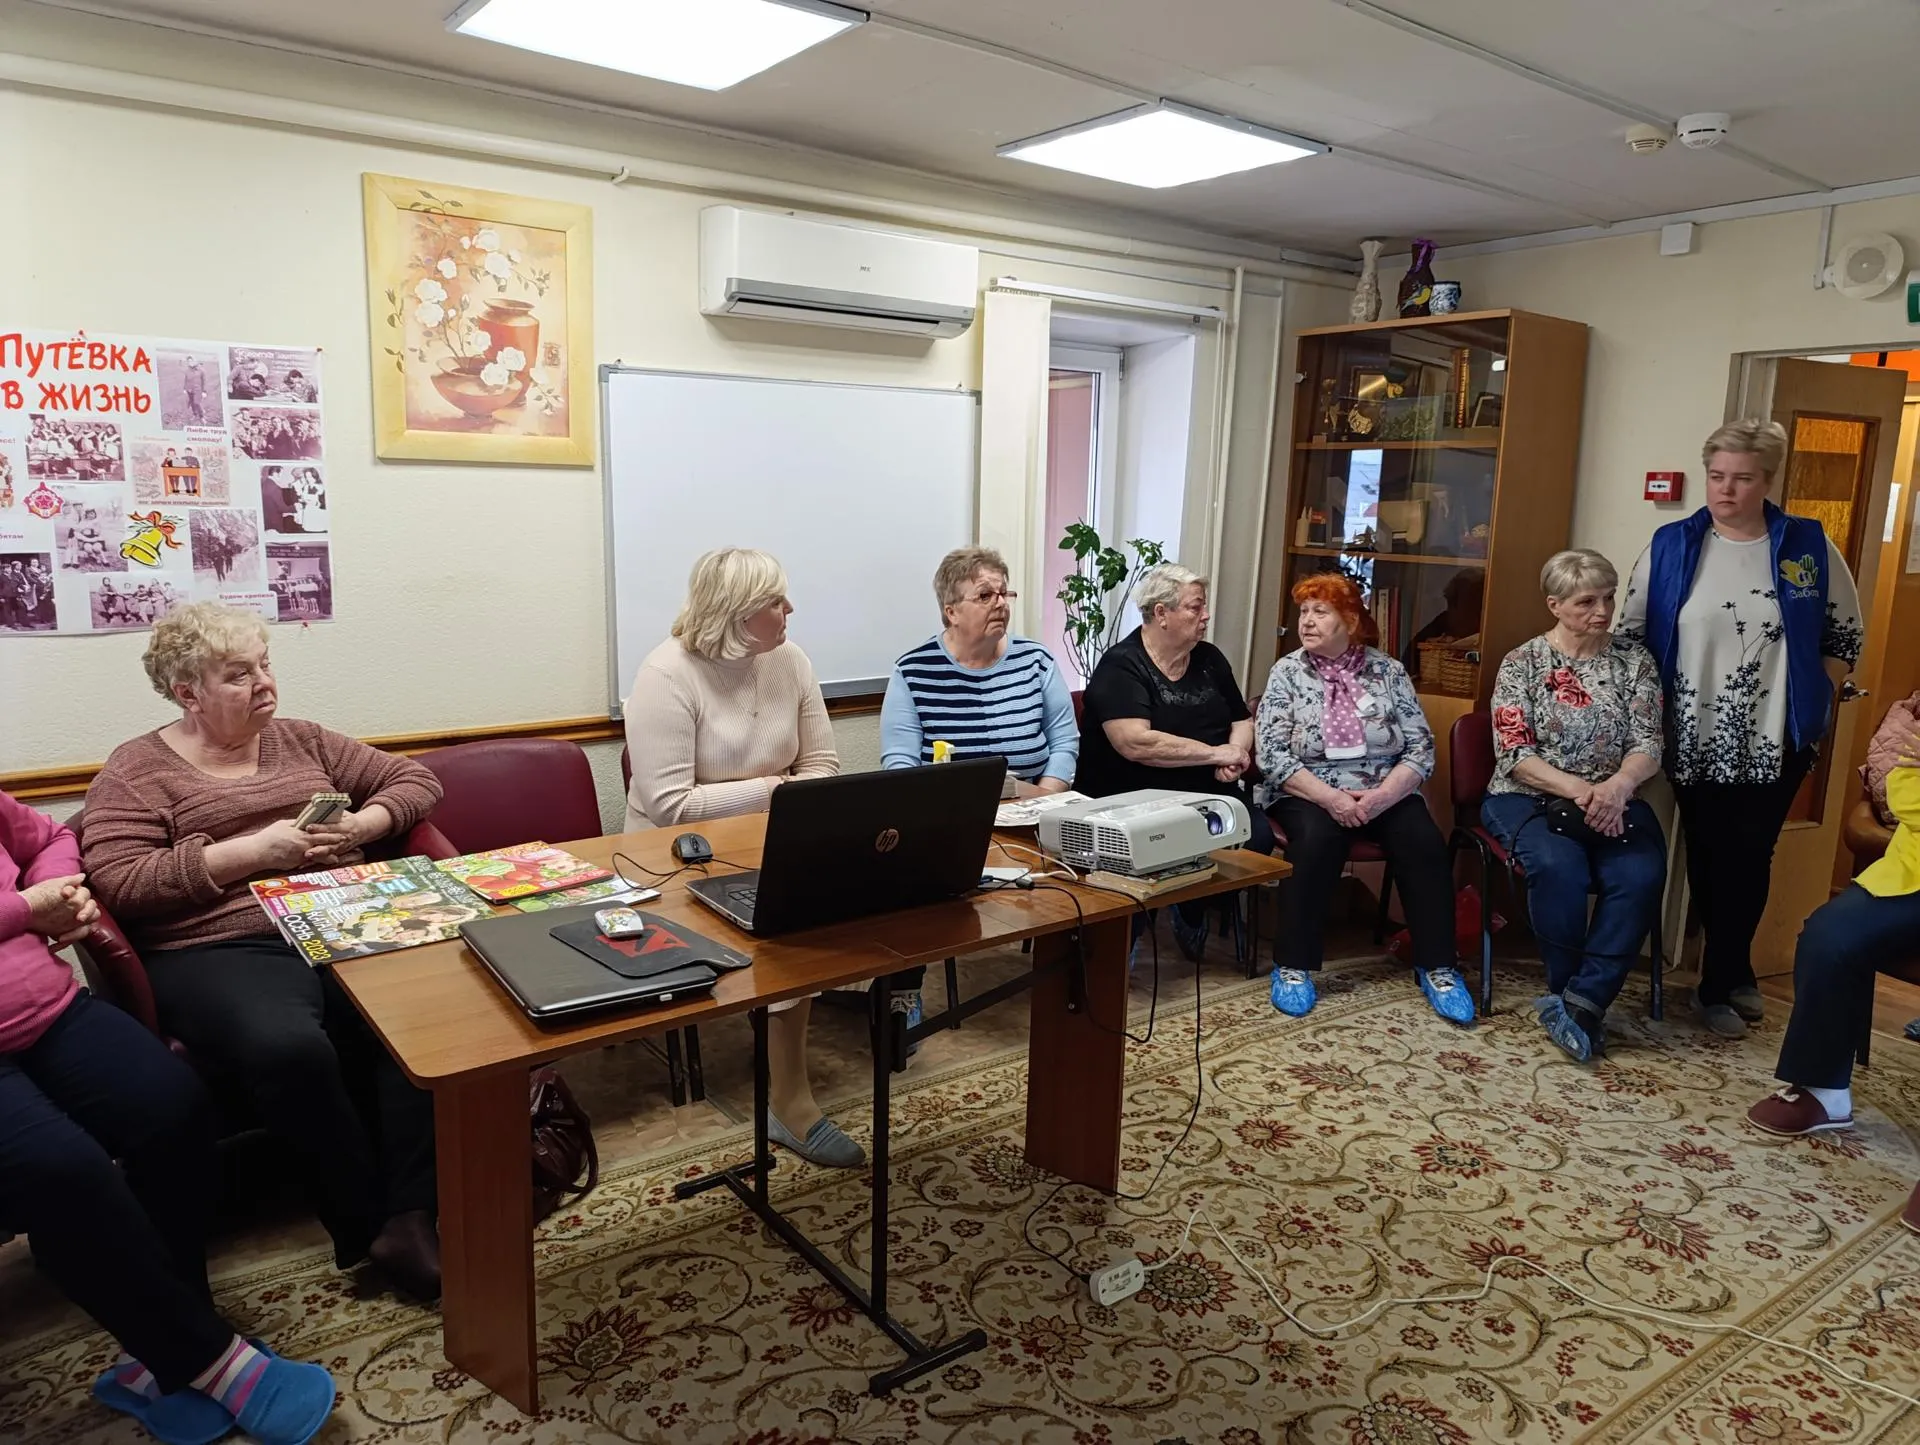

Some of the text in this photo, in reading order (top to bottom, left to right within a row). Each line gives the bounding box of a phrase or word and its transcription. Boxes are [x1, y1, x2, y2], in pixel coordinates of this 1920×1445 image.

[875, 828, 900, 853] hp
[1149, 832, 1166, 843] EPSON
[302, 938, 332, 961] 2023
